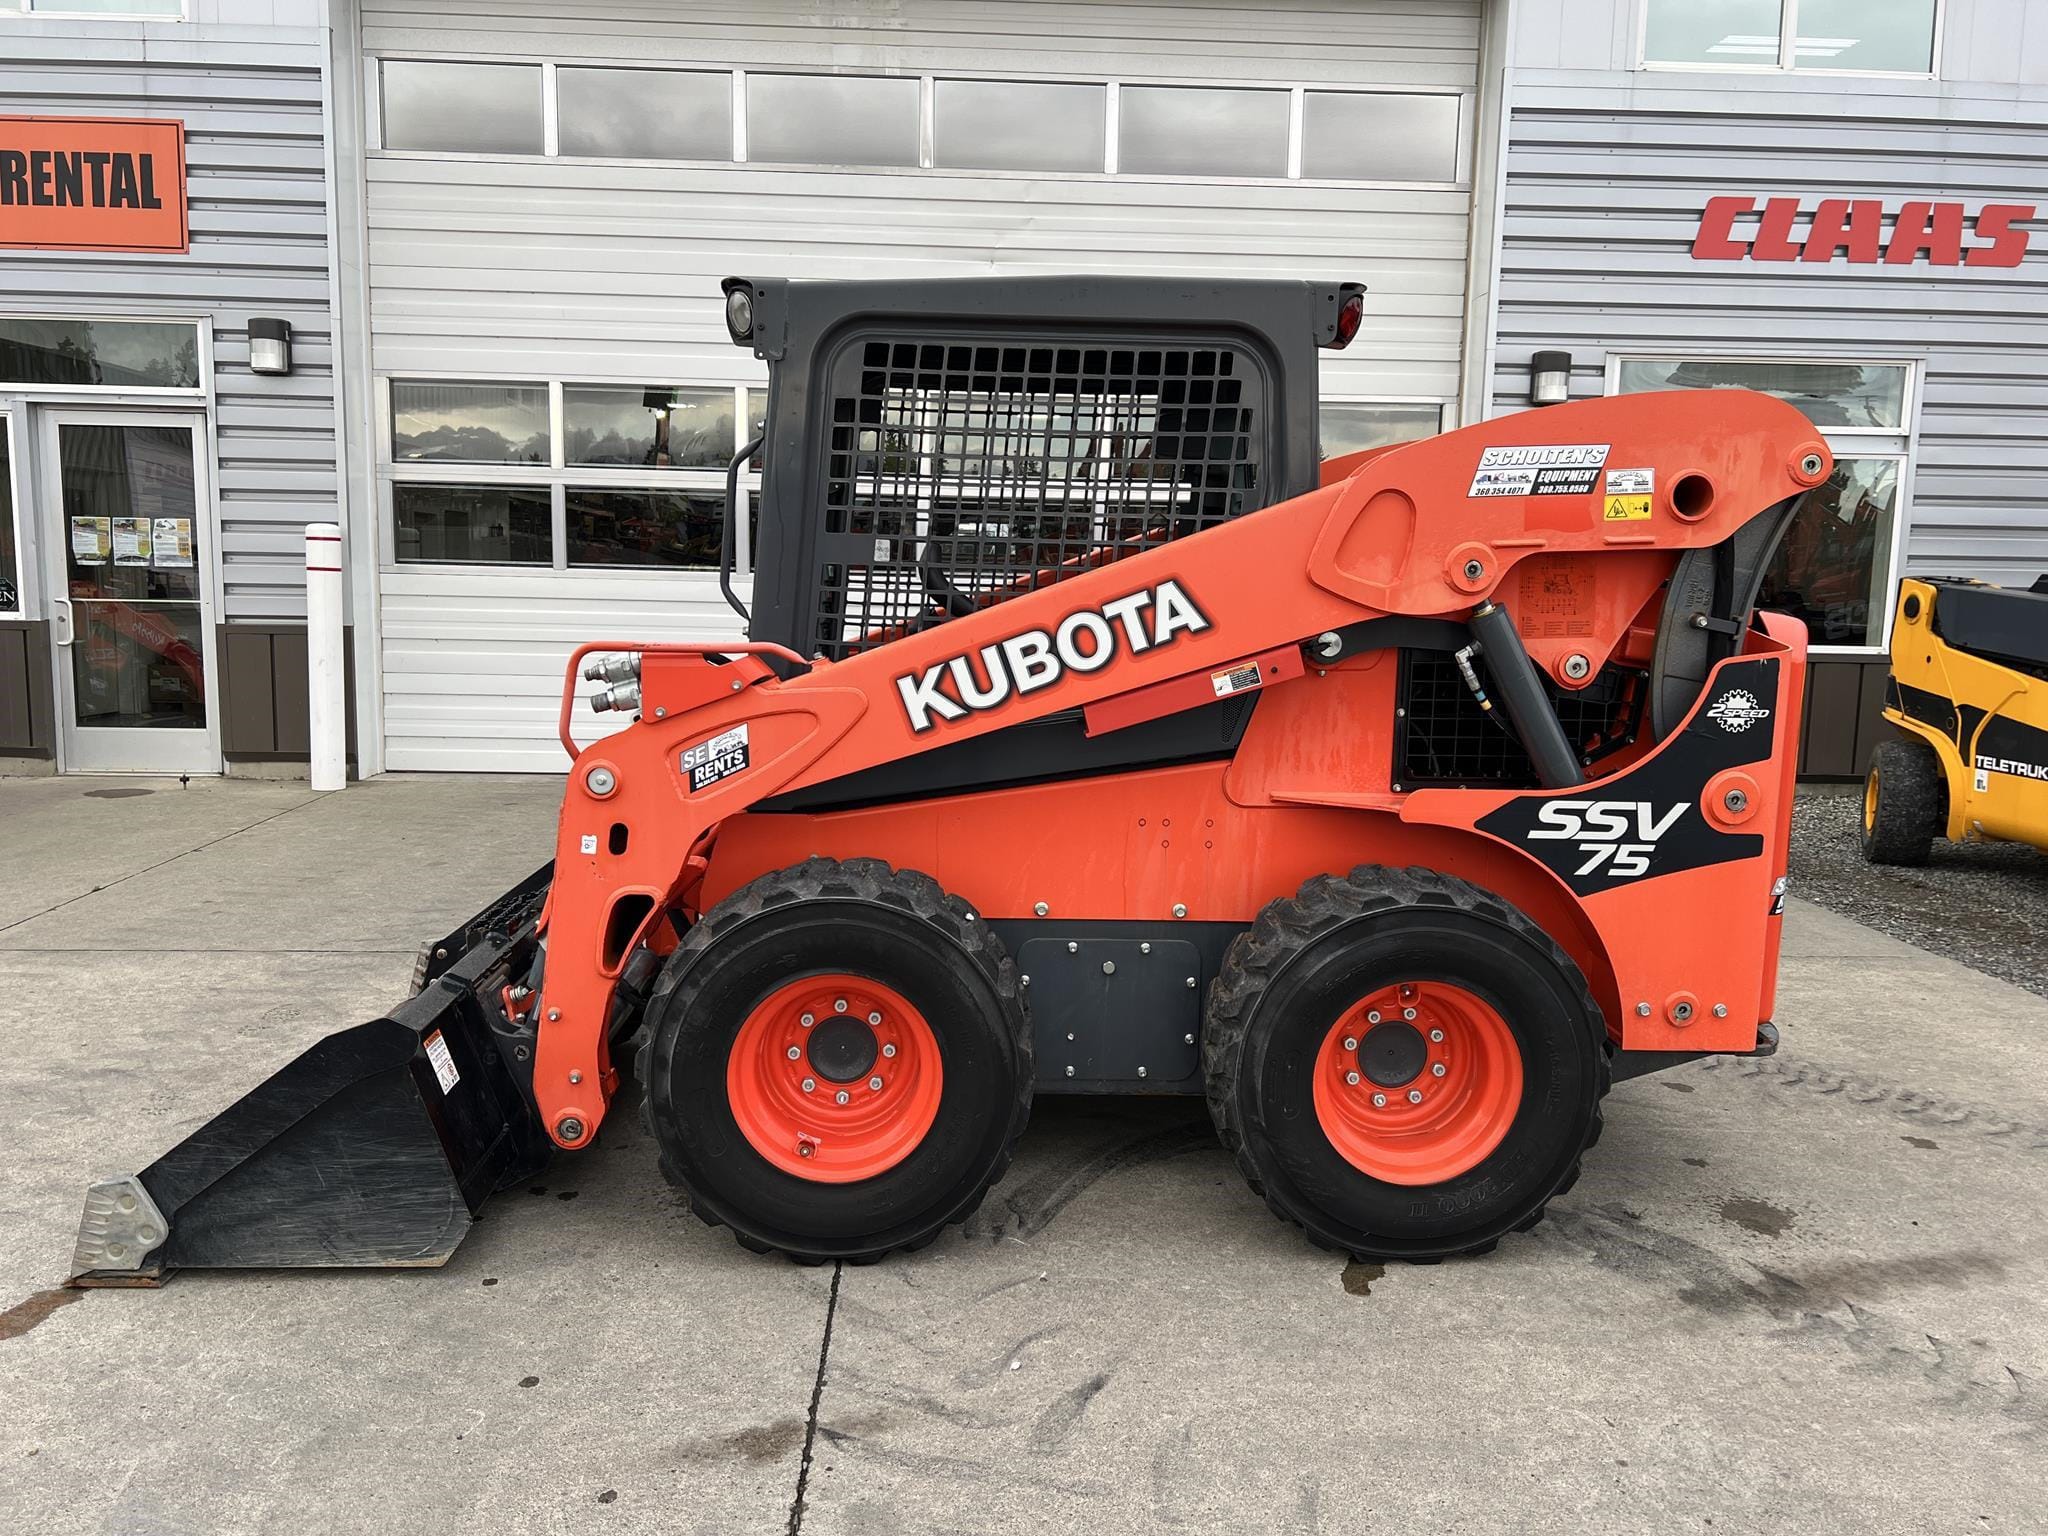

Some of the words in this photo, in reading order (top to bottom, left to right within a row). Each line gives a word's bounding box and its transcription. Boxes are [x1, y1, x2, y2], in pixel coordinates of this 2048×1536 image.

[0, 150, 162, 209] RENTAL
[1691, 196, 2037, 268] CLAAS
[1482, 447, 1606, 467] SCHOLTEN'S
[1537, 469, 1600, 482] EQUIPMENT
[897, 580, 1209, 732] KUBOTA
[683, 745, 706, 769] SE
[694, 749, 744, 784] RENTS
[1975, 754, 2048, 780] TELETRUK
[1527, 801, 1692, 841] SSV
[1573, 844, 1655, 876] 75
